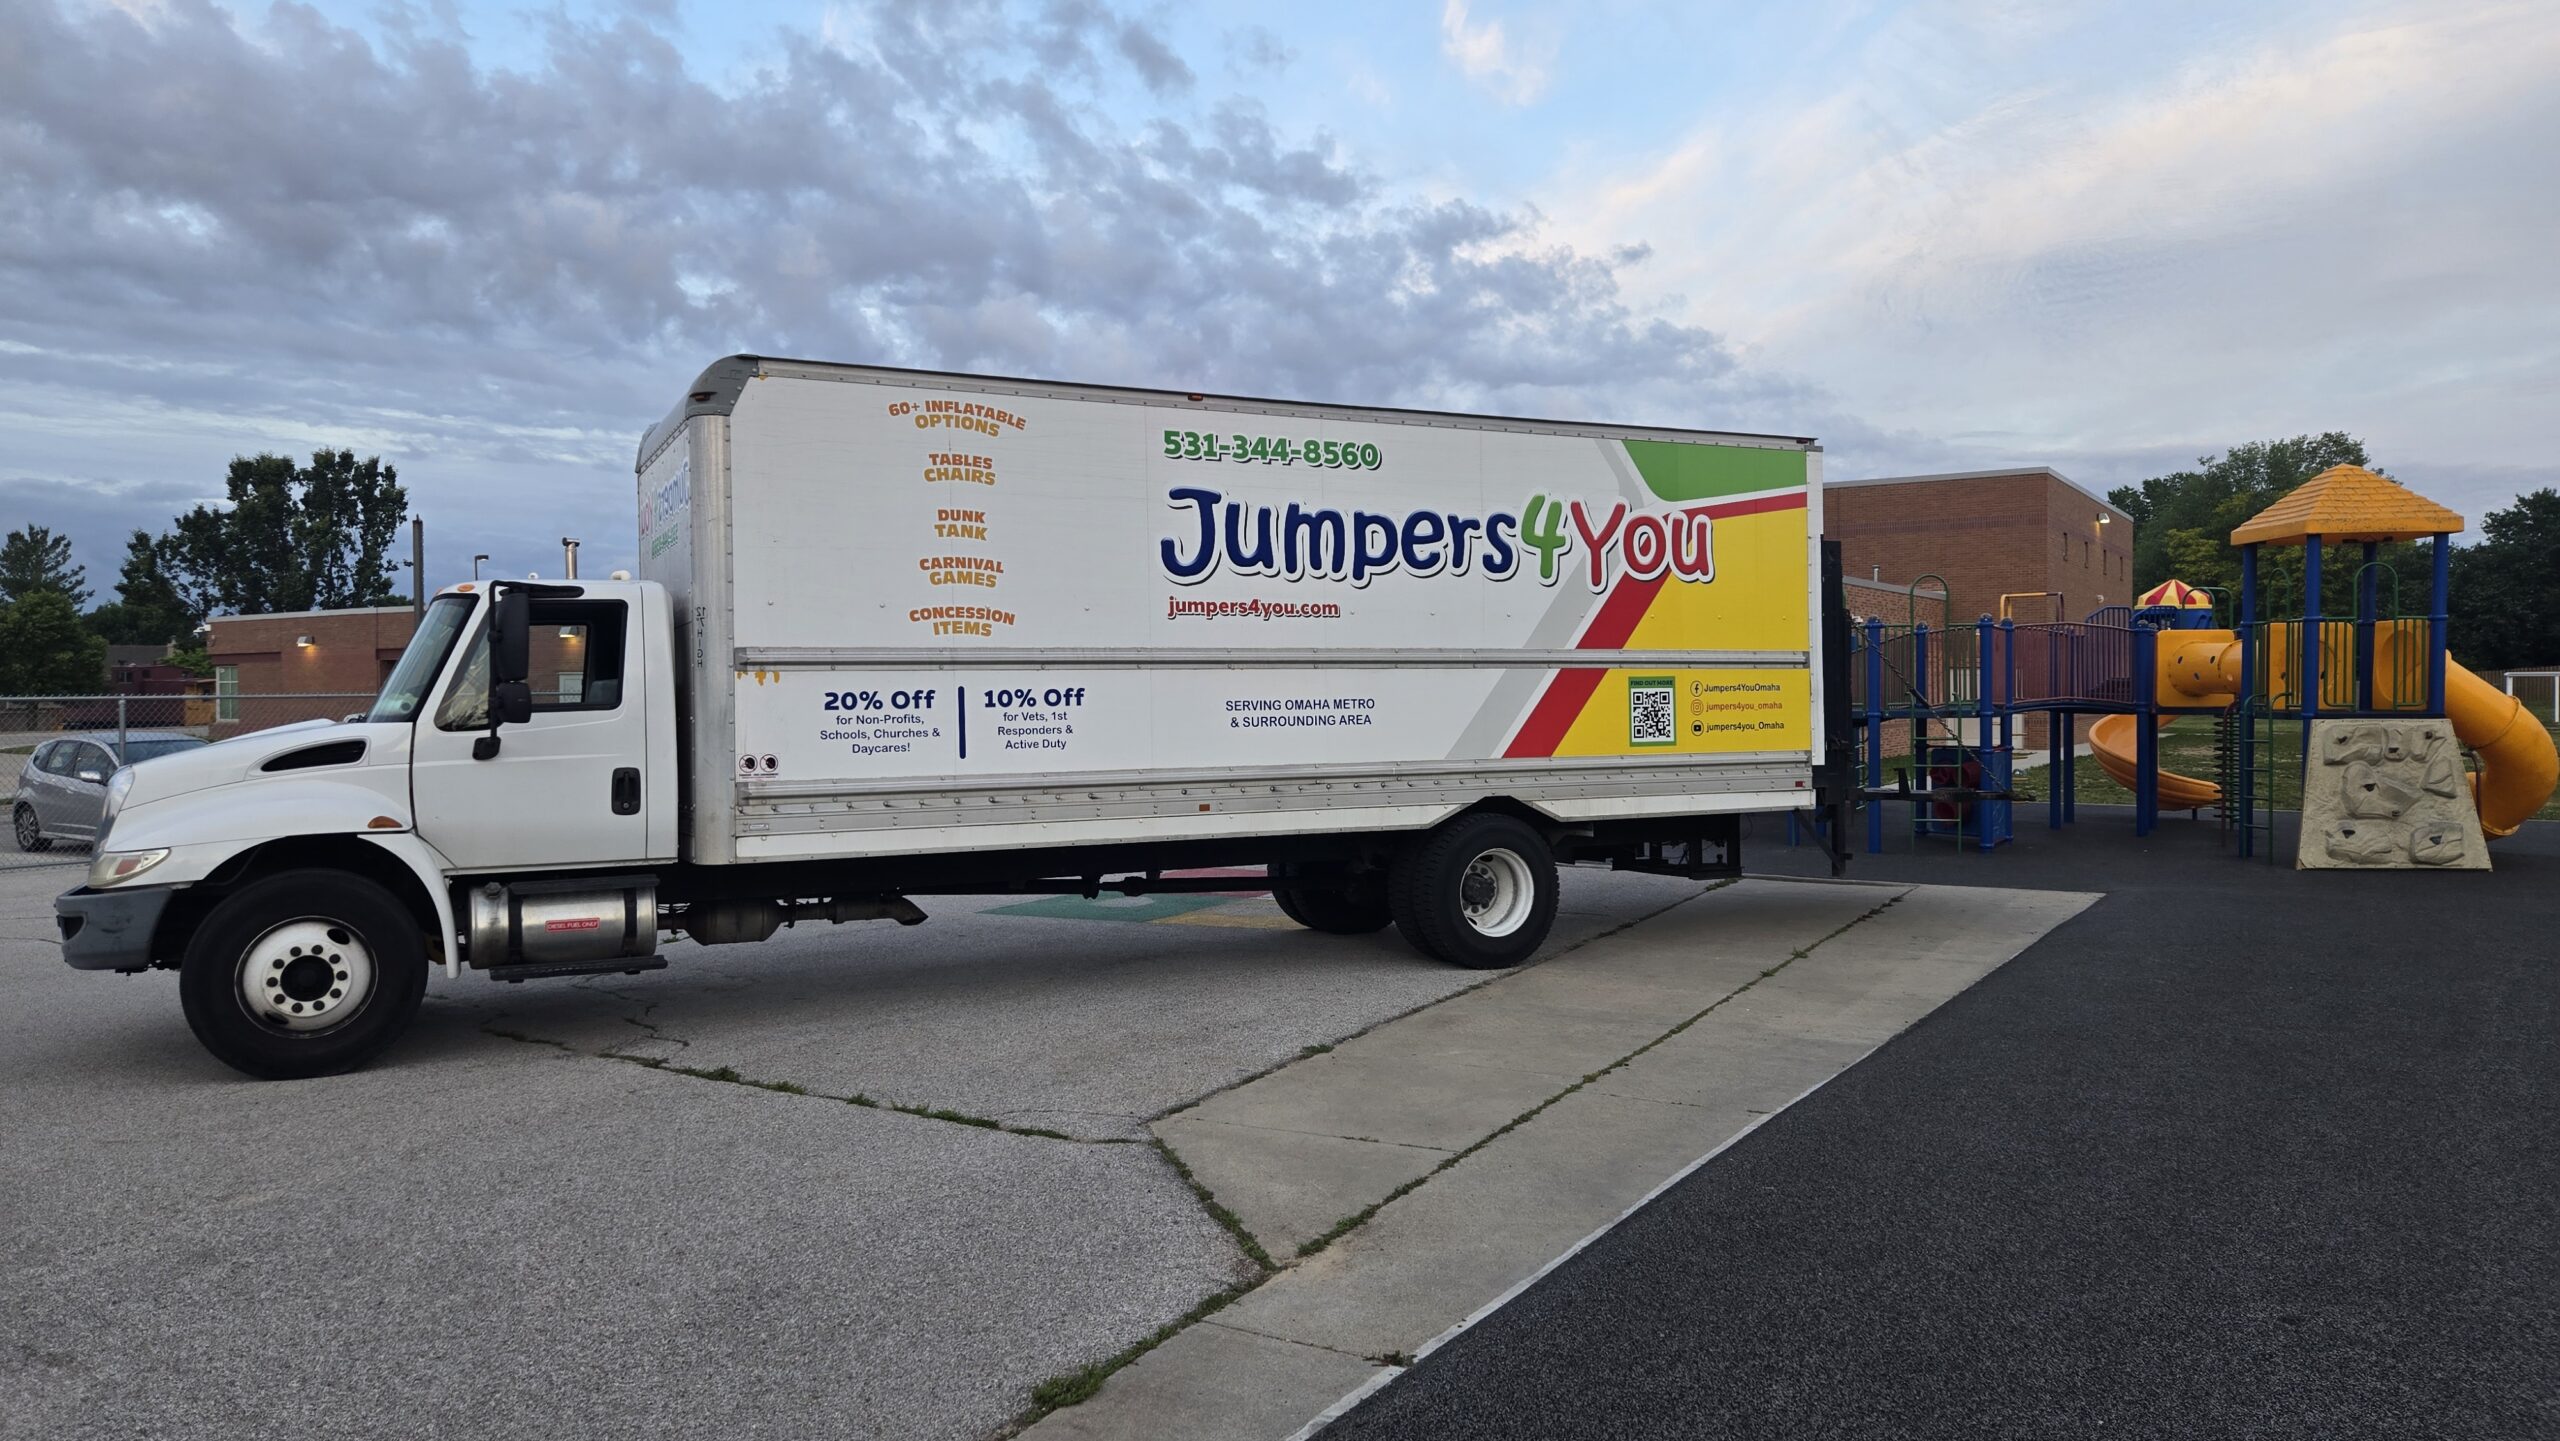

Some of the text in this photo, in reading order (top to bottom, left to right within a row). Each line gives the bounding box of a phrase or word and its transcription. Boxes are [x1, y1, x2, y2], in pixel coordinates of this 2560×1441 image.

[889, 400, 1026, 430] 60+ INFLATABLE
[914, 414, 1000, 437] OPTIONS
[1163, 430, 1380, 468] 531-344-8560
[928, 453, 993, 469] TABLES
[924, 468, 996, 486] CHAIRS
[937, 509, 986, 524] DUNK
[934, 524, 988, 541] TANK
[1160, 485, 1714, 588] Jumpers4You
[919, 556, 1004, 573] CARNIVAL
[929, 571, 997, 588] GAMES
[909, 606, 1016, 625] CONCESSION
[1168, 595, 1340, 620] jumpers4you.com
[932, 620, 992, 637] ITEMS
[1703, 683, 1781, 693] Jumpers4YouOmaha
[824, 689, 936, 710] 20% Off
[984, 687, 1086, 708] 10% Off
[1225, 698, 1375, 711] SERVING OMAHA METRO
[1705, 701, 1783, 713] jumpers4you_omaha
[836, 714, 925, 725] for Non-Profits,
[1003, 711, 1068, 722] for Vets, 1st
[1230, 714, 1372, 728] & SURROUNDING AREA
[820, 727, 941, 741] Schools, Churches &
[997, 724, 1073, 737] Responders &
[1706, 721, 1785, 733] jumpers4you_Omaha
[852, 743, 911, 755] Daycares!
[1005, 739, 1067, 750] Active Duty
